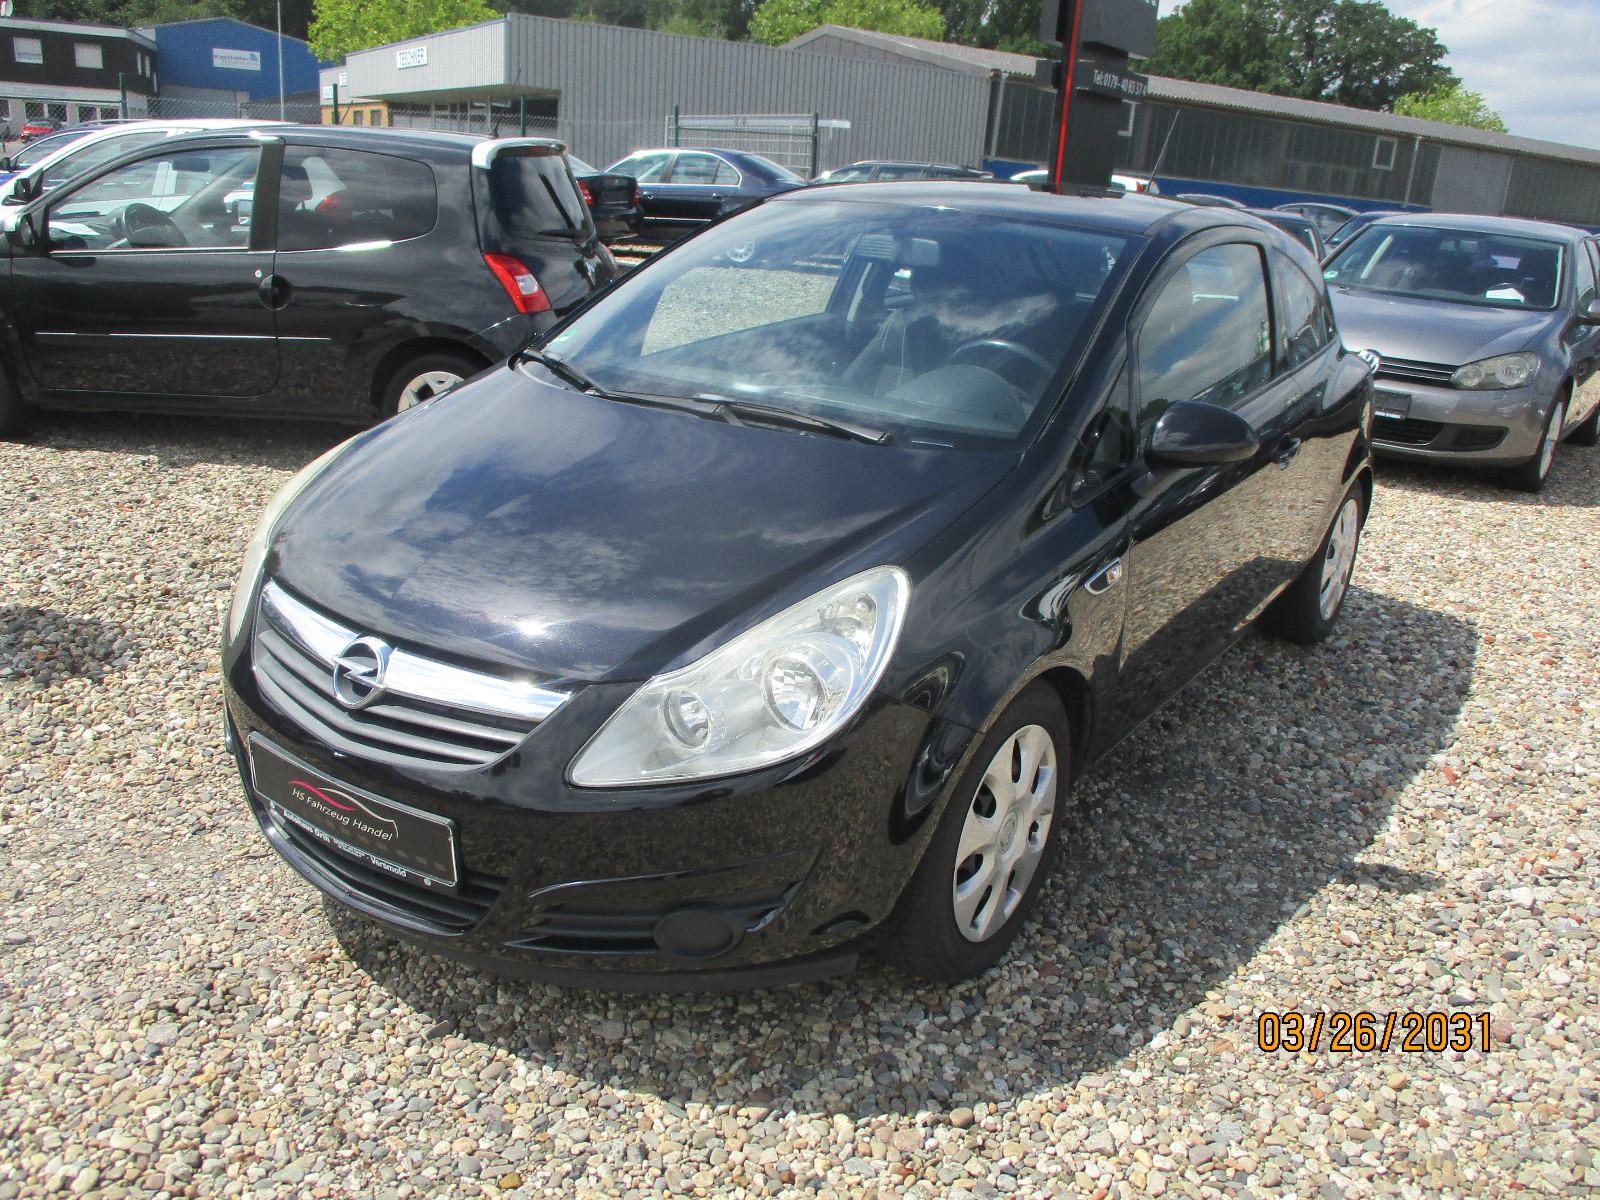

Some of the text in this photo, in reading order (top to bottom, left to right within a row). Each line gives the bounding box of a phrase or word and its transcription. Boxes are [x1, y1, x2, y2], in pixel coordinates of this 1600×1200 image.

[292, 788, 393, 841] HS Fahrzeug Handel
